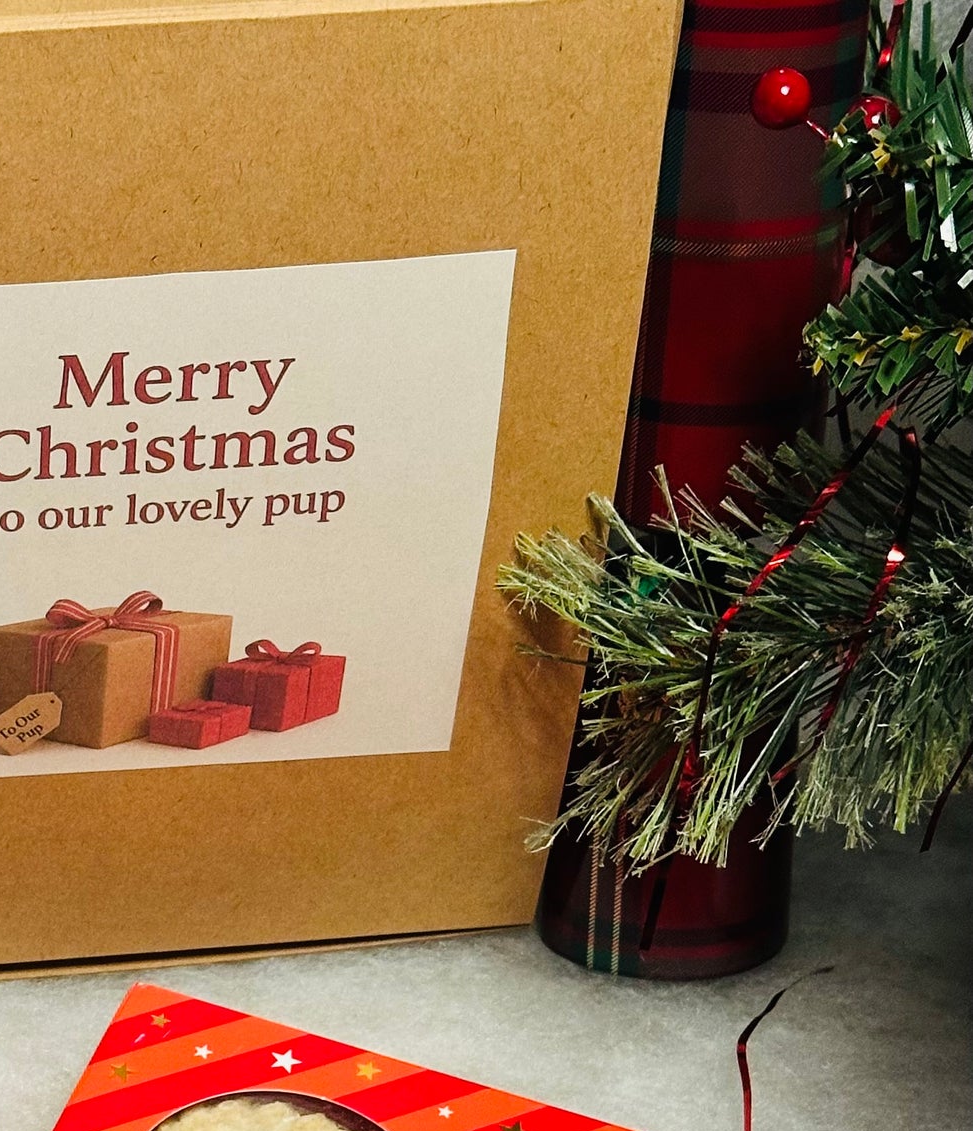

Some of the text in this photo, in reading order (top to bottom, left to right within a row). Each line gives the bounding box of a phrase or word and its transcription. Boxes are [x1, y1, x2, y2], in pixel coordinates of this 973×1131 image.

[53, 352, 295, 415] Merry
[38, 504, 113, 530] our
[126, 488, 253, 528] lovely
[262, 489, 346, 526] pup
[15, 708, 41, 727] Our
[16, 724, 43, 742] Pup
